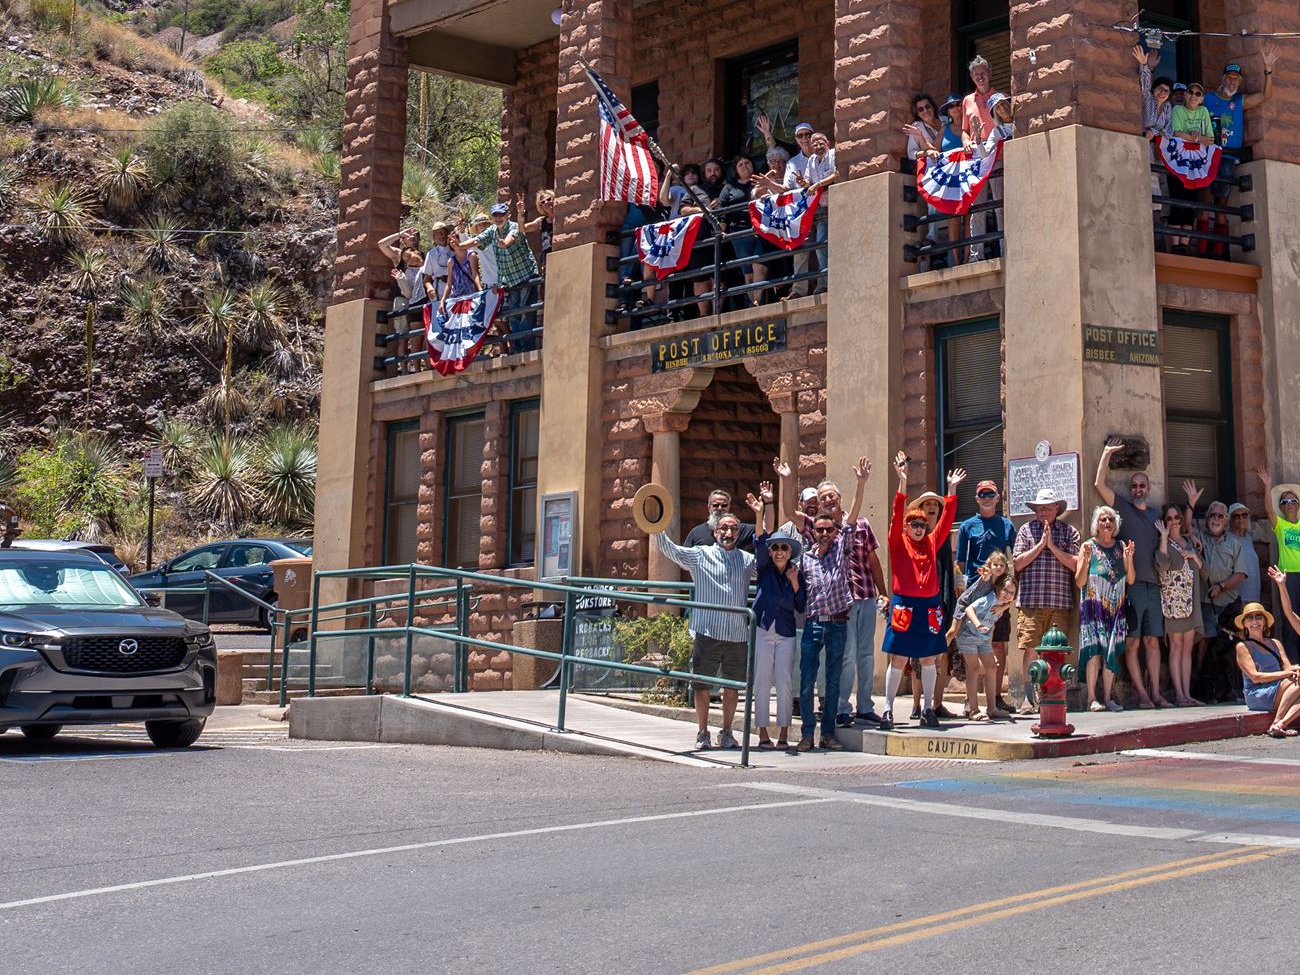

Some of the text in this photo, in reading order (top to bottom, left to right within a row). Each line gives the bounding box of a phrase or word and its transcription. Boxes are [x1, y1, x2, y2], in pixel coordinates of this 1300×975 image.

[658, 323, 777, 362] POST OFFICE
[1086, 328, 1156, 347] POST OFFICE
[665, 357, 689, 369] BISBEE
[746, 343, 769, 354] 85603
[1085, 348, 1159, 365] BISBEE ARIZONA
[927, 740, 978, 756] CAUTION
